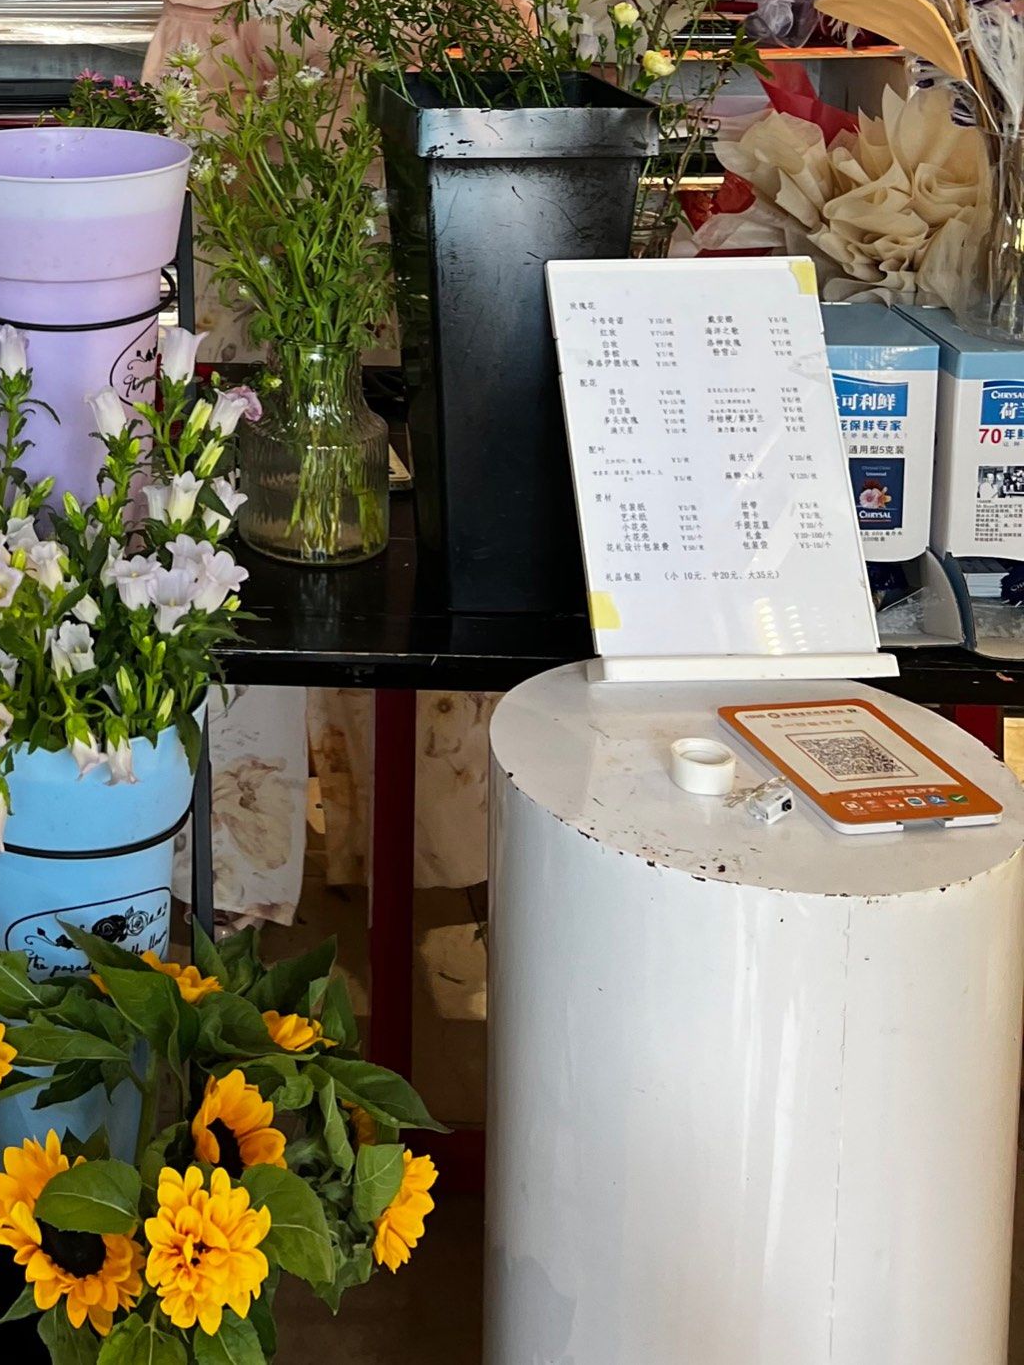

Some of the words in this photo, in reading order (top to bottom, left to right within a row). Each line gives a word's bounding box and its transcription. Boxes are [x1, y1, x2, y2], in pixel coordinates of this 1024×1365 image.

[590, 316, 623, 325] 卡布奇诺
[705, 327, 739, 335] 海洋之歌
[610, 397, 626, 405] 百合
[836, 393, 896, 411] 可利鲜
[848, 444, 905, 455] 通用型5克装
[619, 502, 647, 512] 包装纸
[746, 531, 764, 541] 礼盒
[606, 542, 671, 553] 花礼设计包装费
[742, 540, 768, 550] 包装袋
[606, 572, 641, 582] 礼品包装
